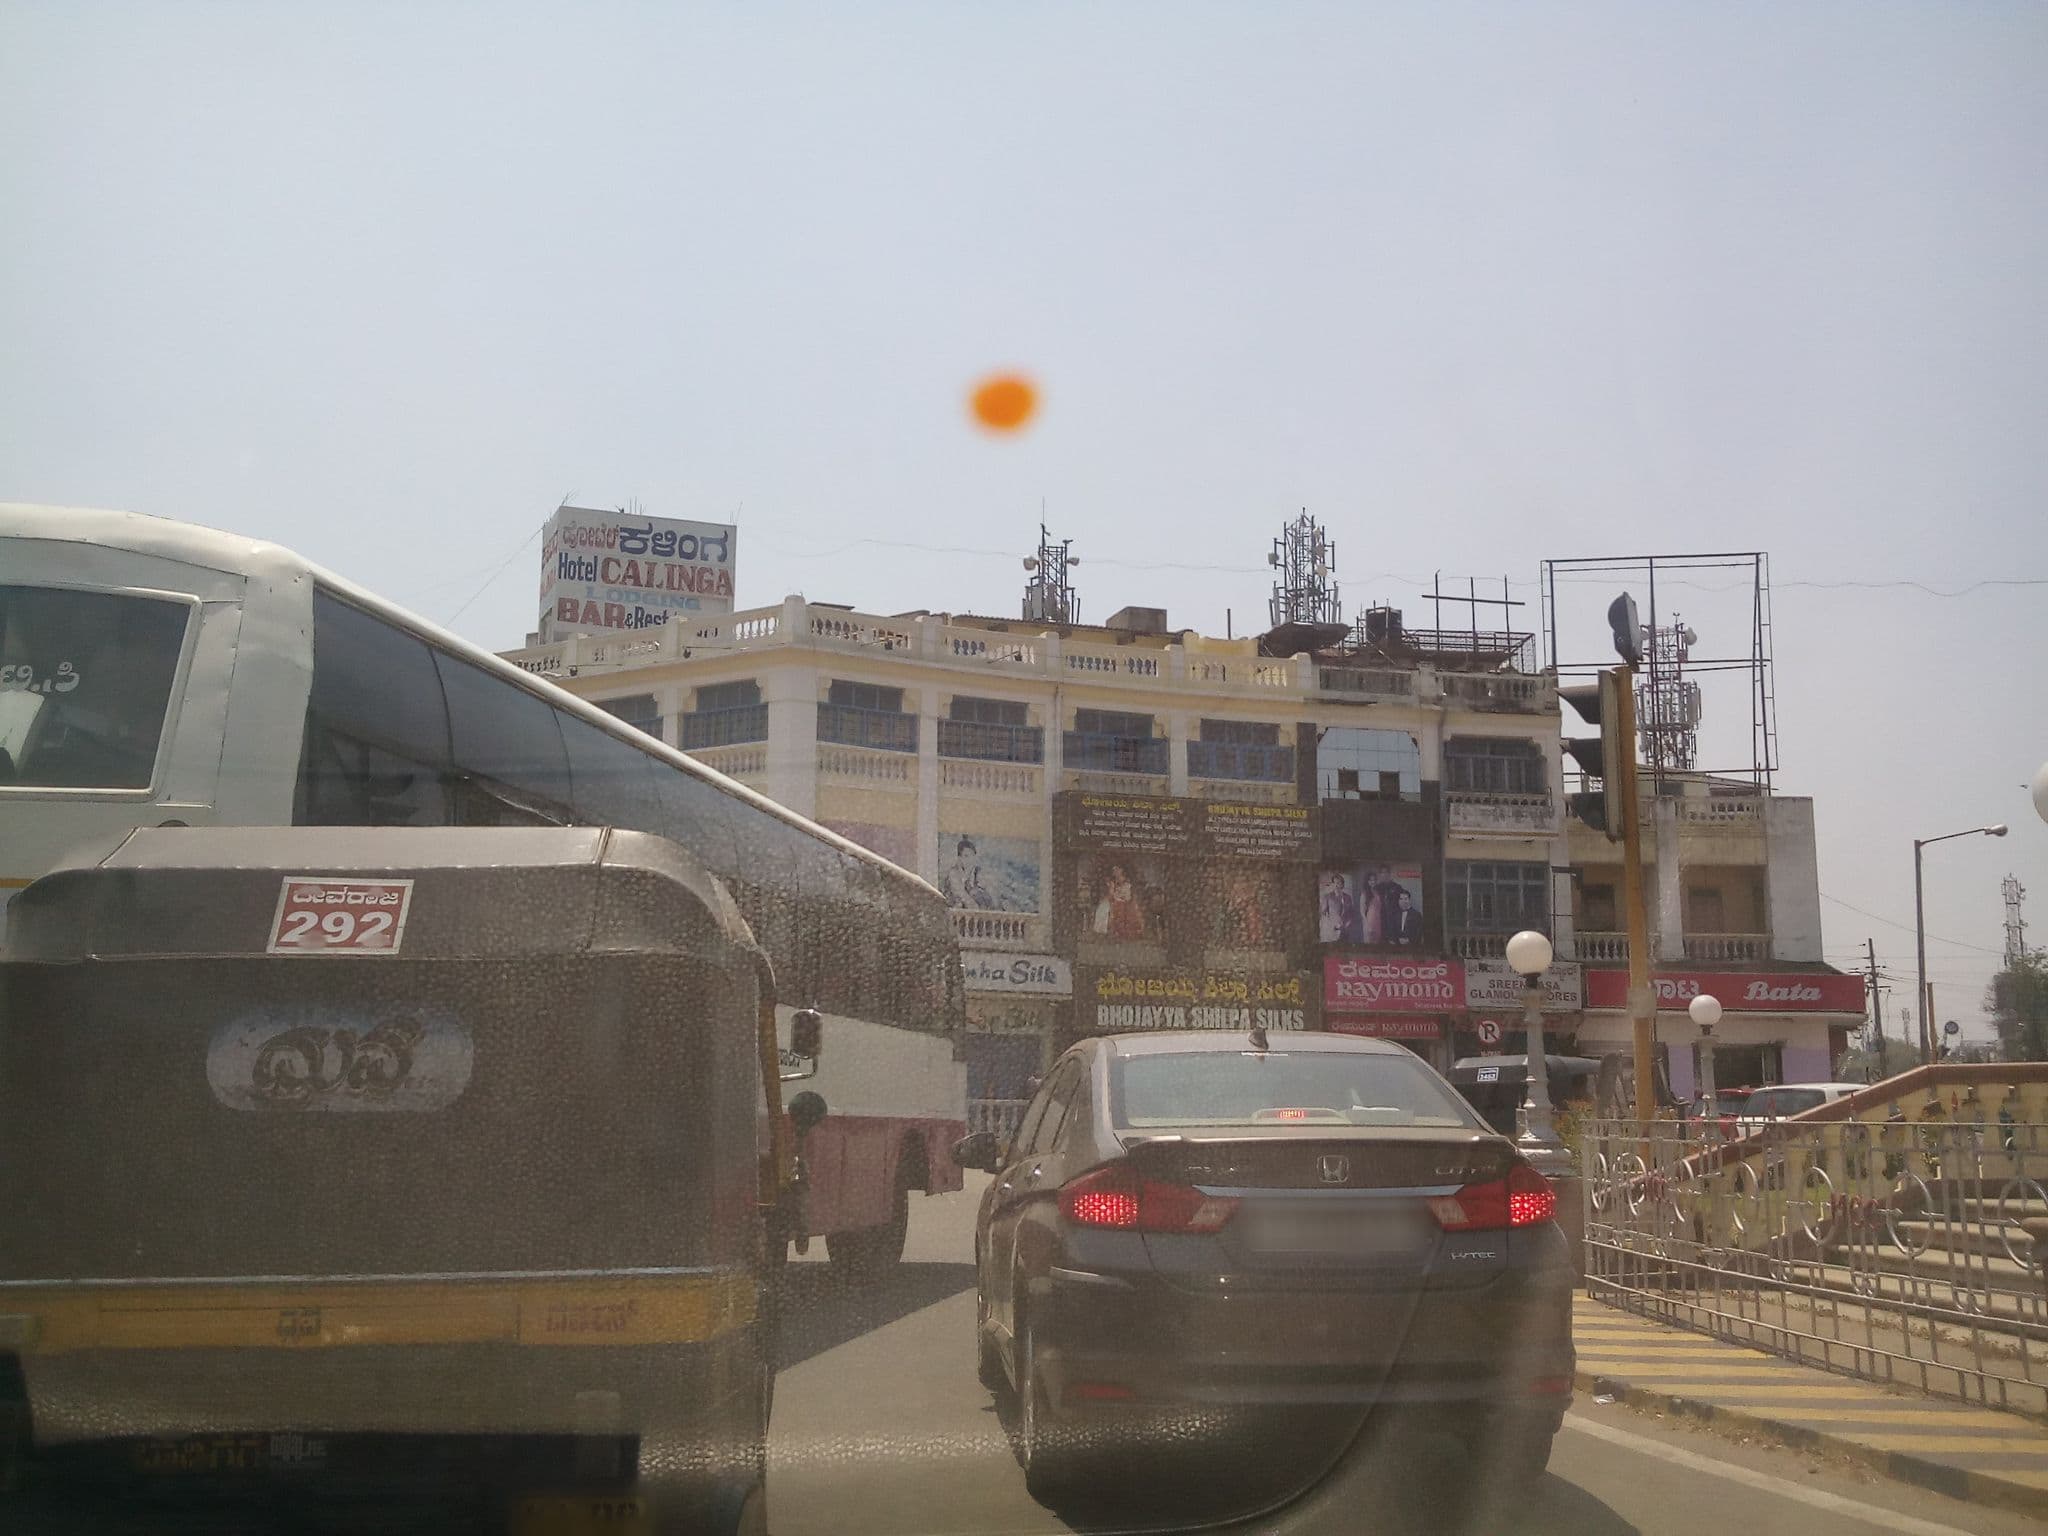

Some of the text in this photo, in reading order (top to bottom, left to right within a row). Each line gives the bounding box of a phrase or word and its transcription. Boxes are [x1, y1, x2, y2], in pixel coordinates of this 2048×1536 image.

[558, 553, 598, 582] Hotel
[601, 557, 734, 597] CALINGA
[557, 597, 625, 628] BAR
[279, 910, 393, 944] 292
[1338, 961, 1448, 980] ರೇಮಂಡ್
[1743, 980, 1822, 1001] Bata
[1097, 1005, 1305, 1031] BHOJAYYA SHILPA SILKS
